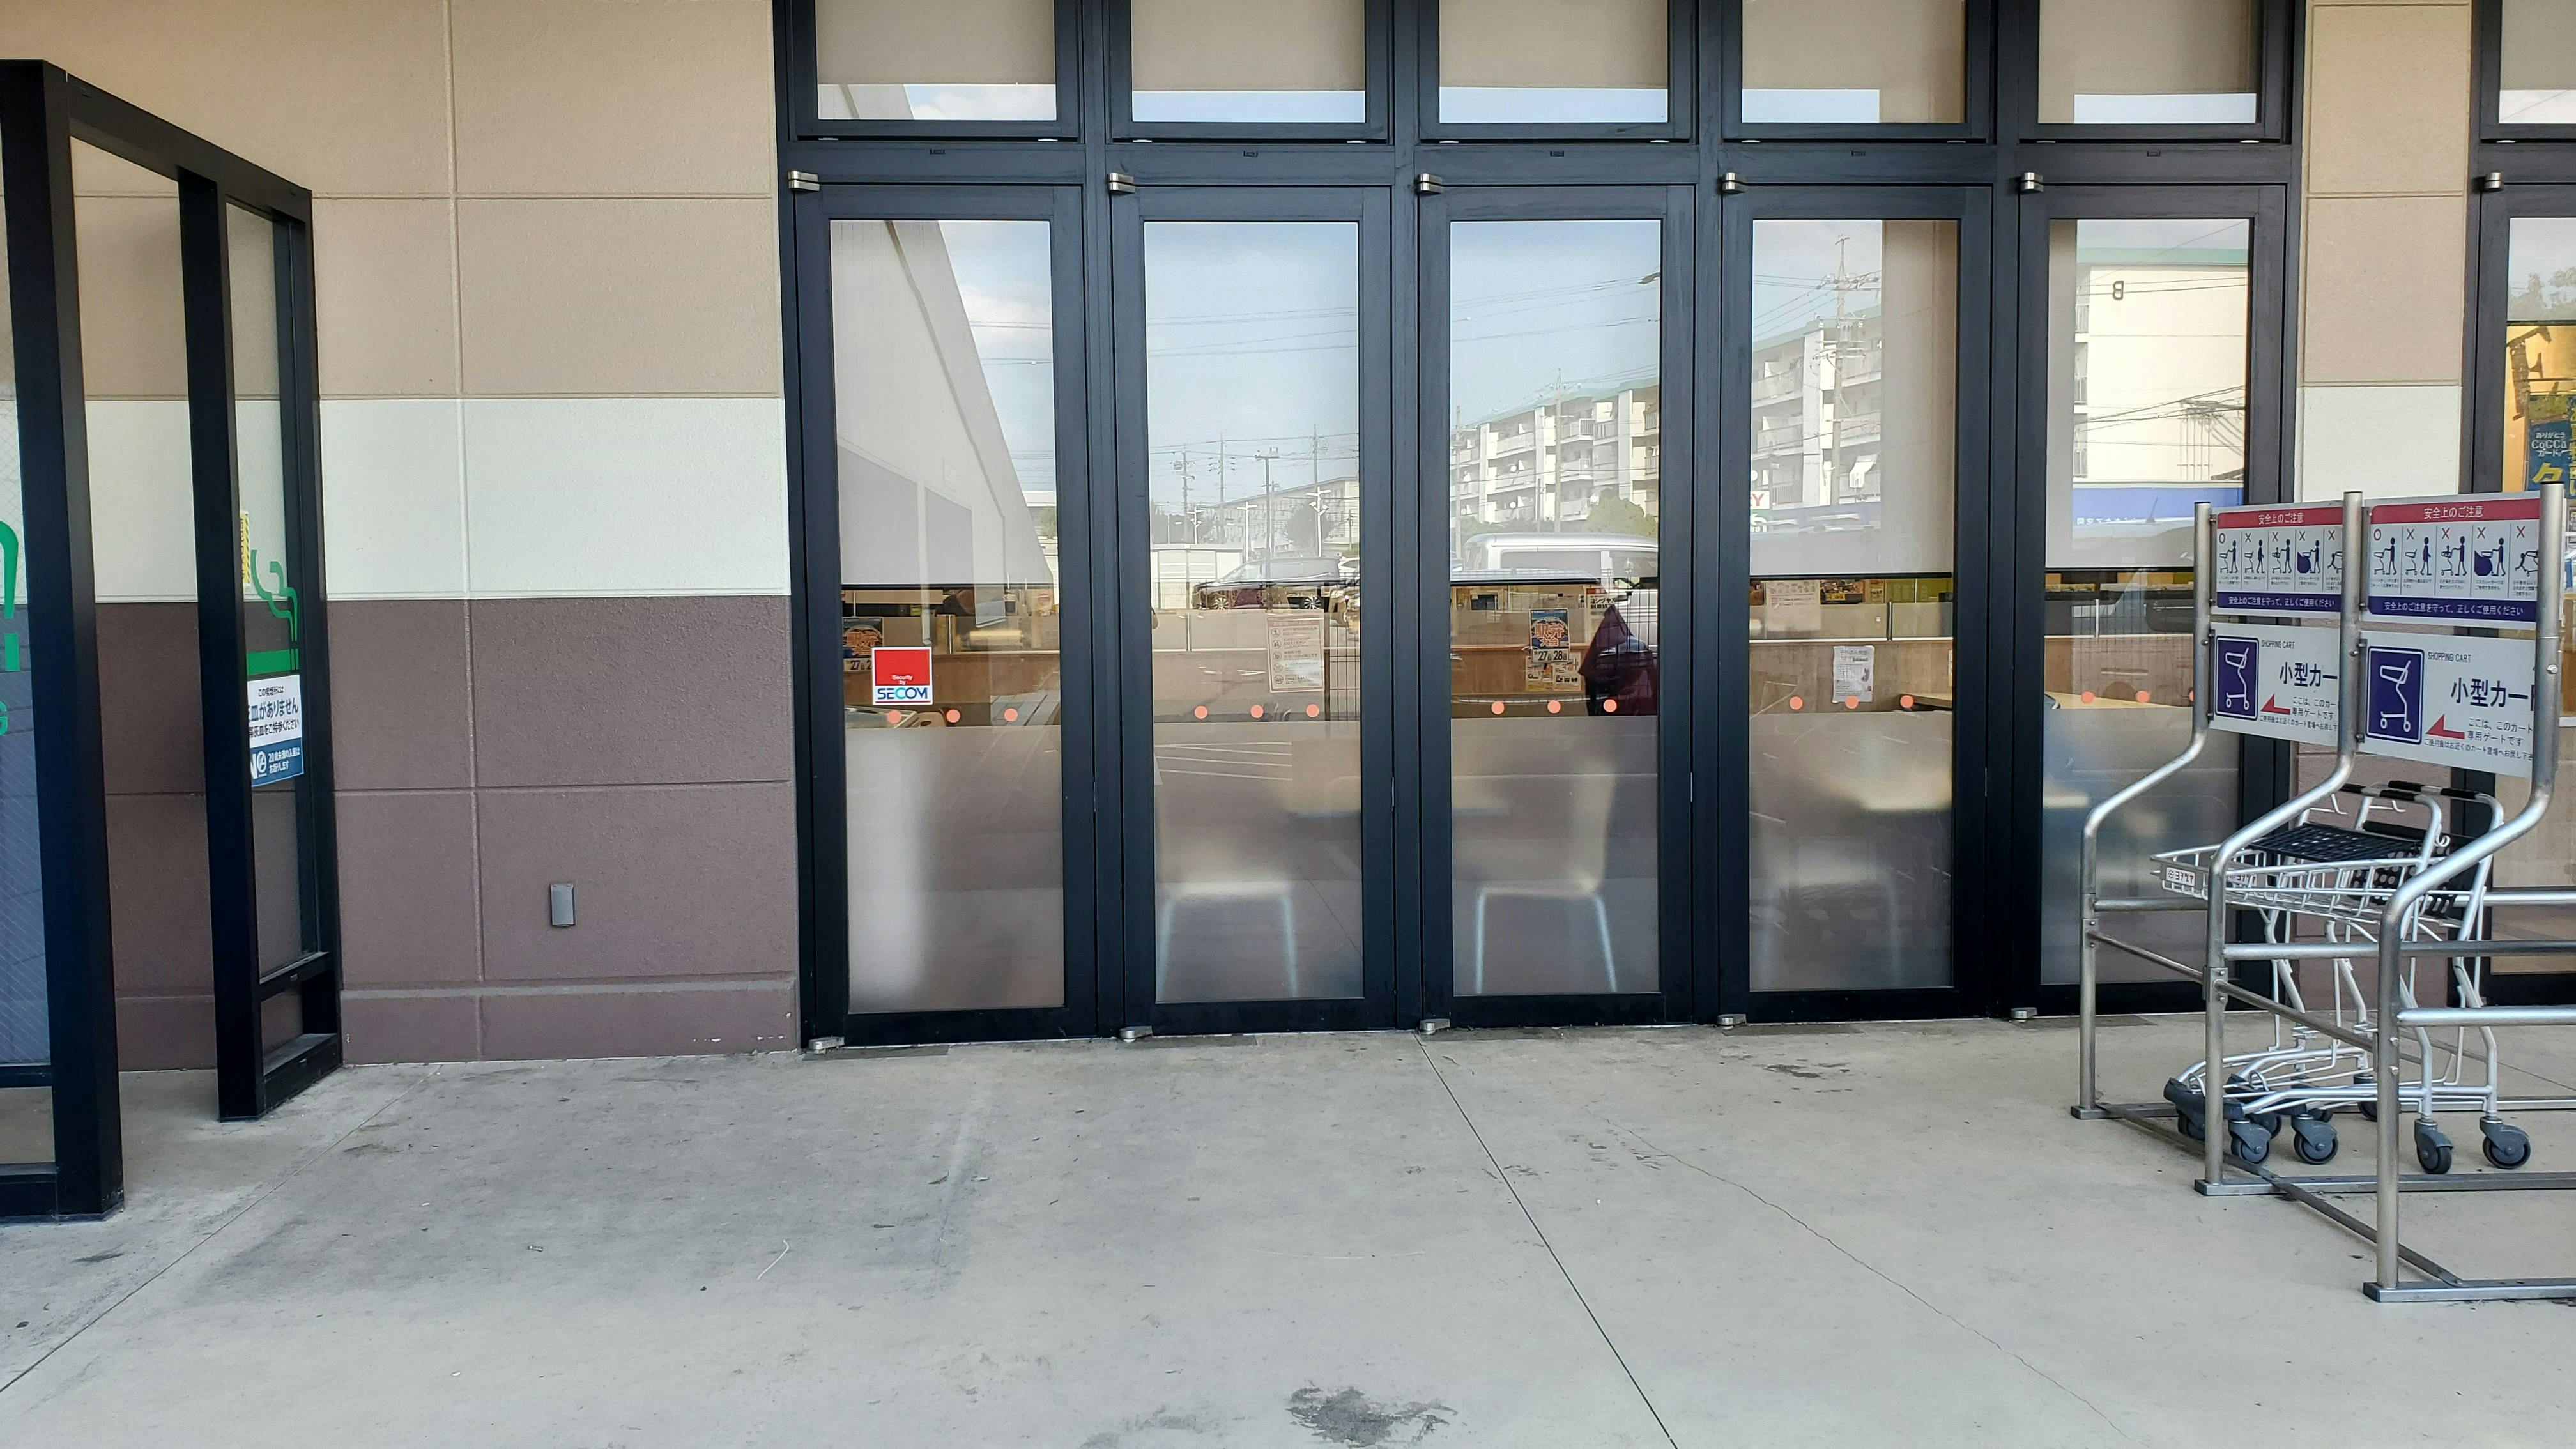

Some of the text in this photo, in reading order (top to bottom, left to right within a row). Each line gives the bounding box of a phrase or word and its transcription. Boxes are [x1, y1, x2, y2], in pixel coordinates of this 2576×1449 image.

[2531, 440, 2566, 449] CoGCa
[2258, 512, 2304, 525] 安全上のご注意
[2424, 505, 2484, 519] 安全上のご注意
[2228, 596, 2334, 608] 安全上のご注意を守って、正しくご使用ください
[2384, 602, 2524, 616] 安全上のご注意を守って、正しくご使用ください
[1534, 622, 1565, 638] 駅弁
[1540, 638, 1560, 647] 大会
[2261, 640, 2295, 649] SHOPPING CART
[2428, 652, 2472, 663] SHOPPING CART
[2279, 661, 2338, 687] 小型カー
[877, 687, 928, 700] SECOM
[2292, 707, 2334, 720] 専用ゲートです
[2468, 718, 2533, 734] ここは、このカート
[2467, 730, 2524, 746] 専用ゲートです
